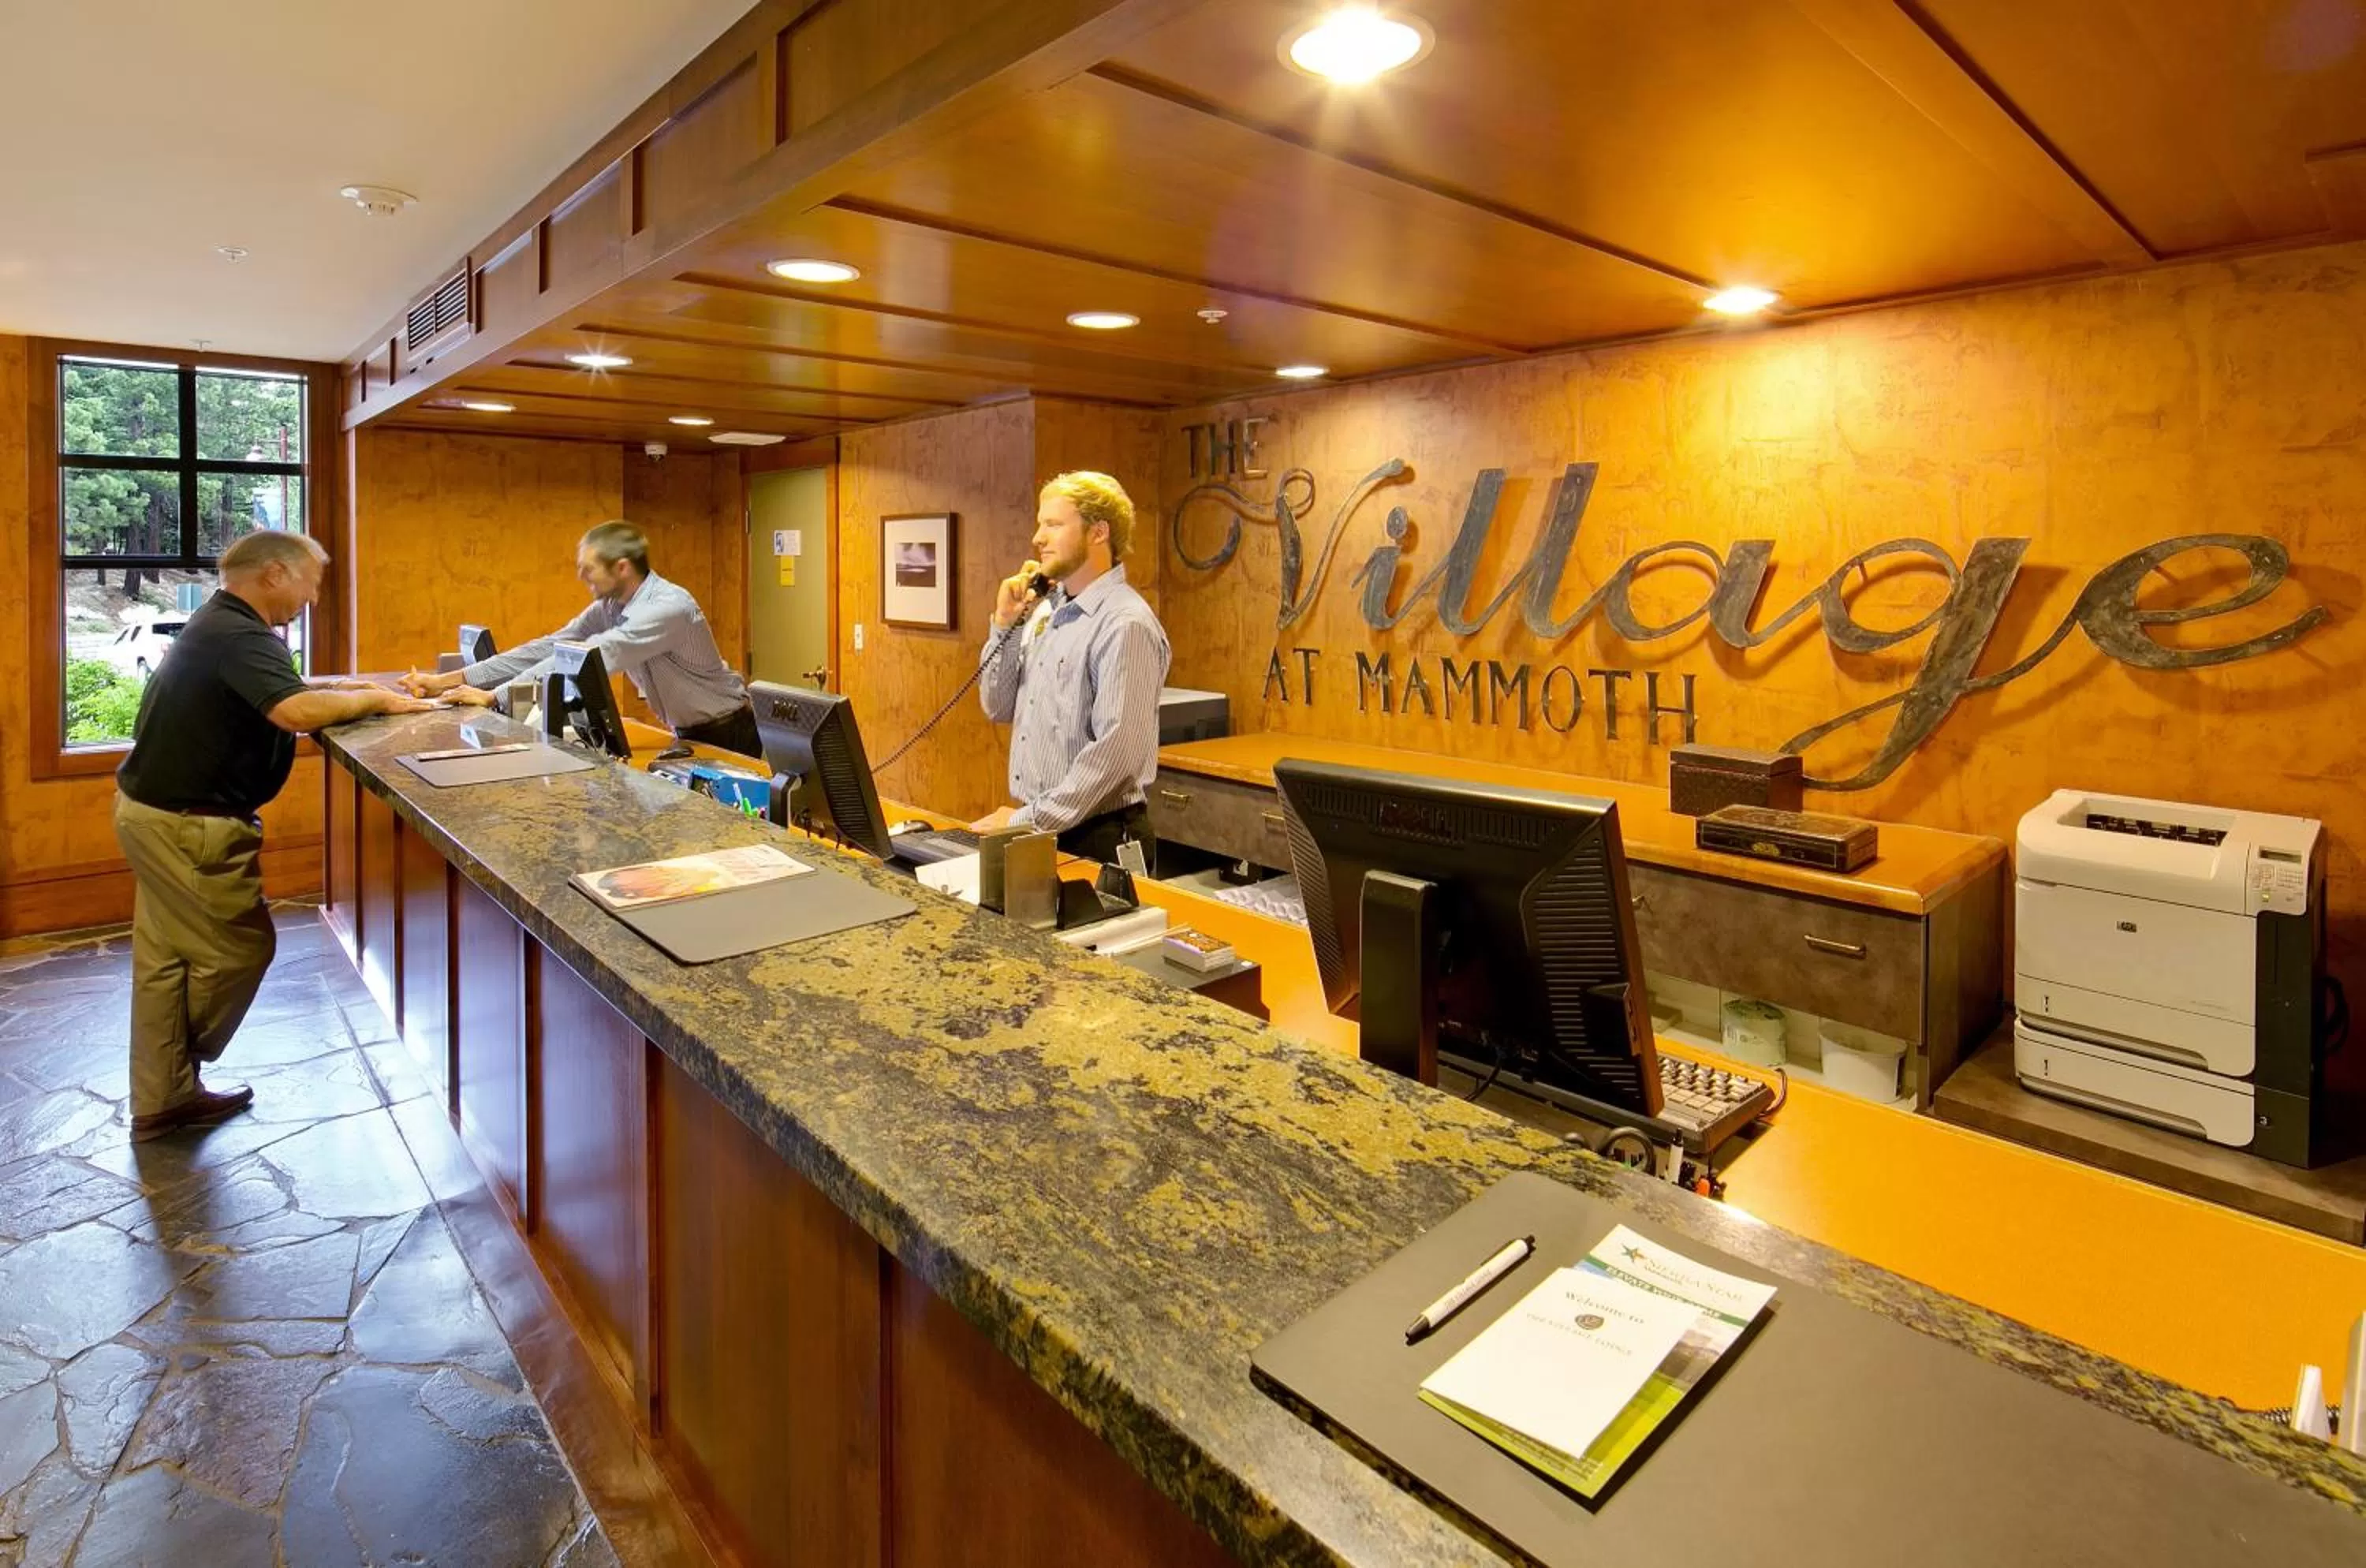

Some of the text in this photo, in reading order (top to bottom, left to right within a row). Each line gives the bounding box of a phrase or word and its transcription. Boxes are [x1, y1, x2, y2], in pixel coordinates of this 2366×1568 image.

[1180, 416, 1269, 480] THE
[1174, 457, 2329, 790] Village
[1262, 647, 1697, 745] AT MAMMOTH
